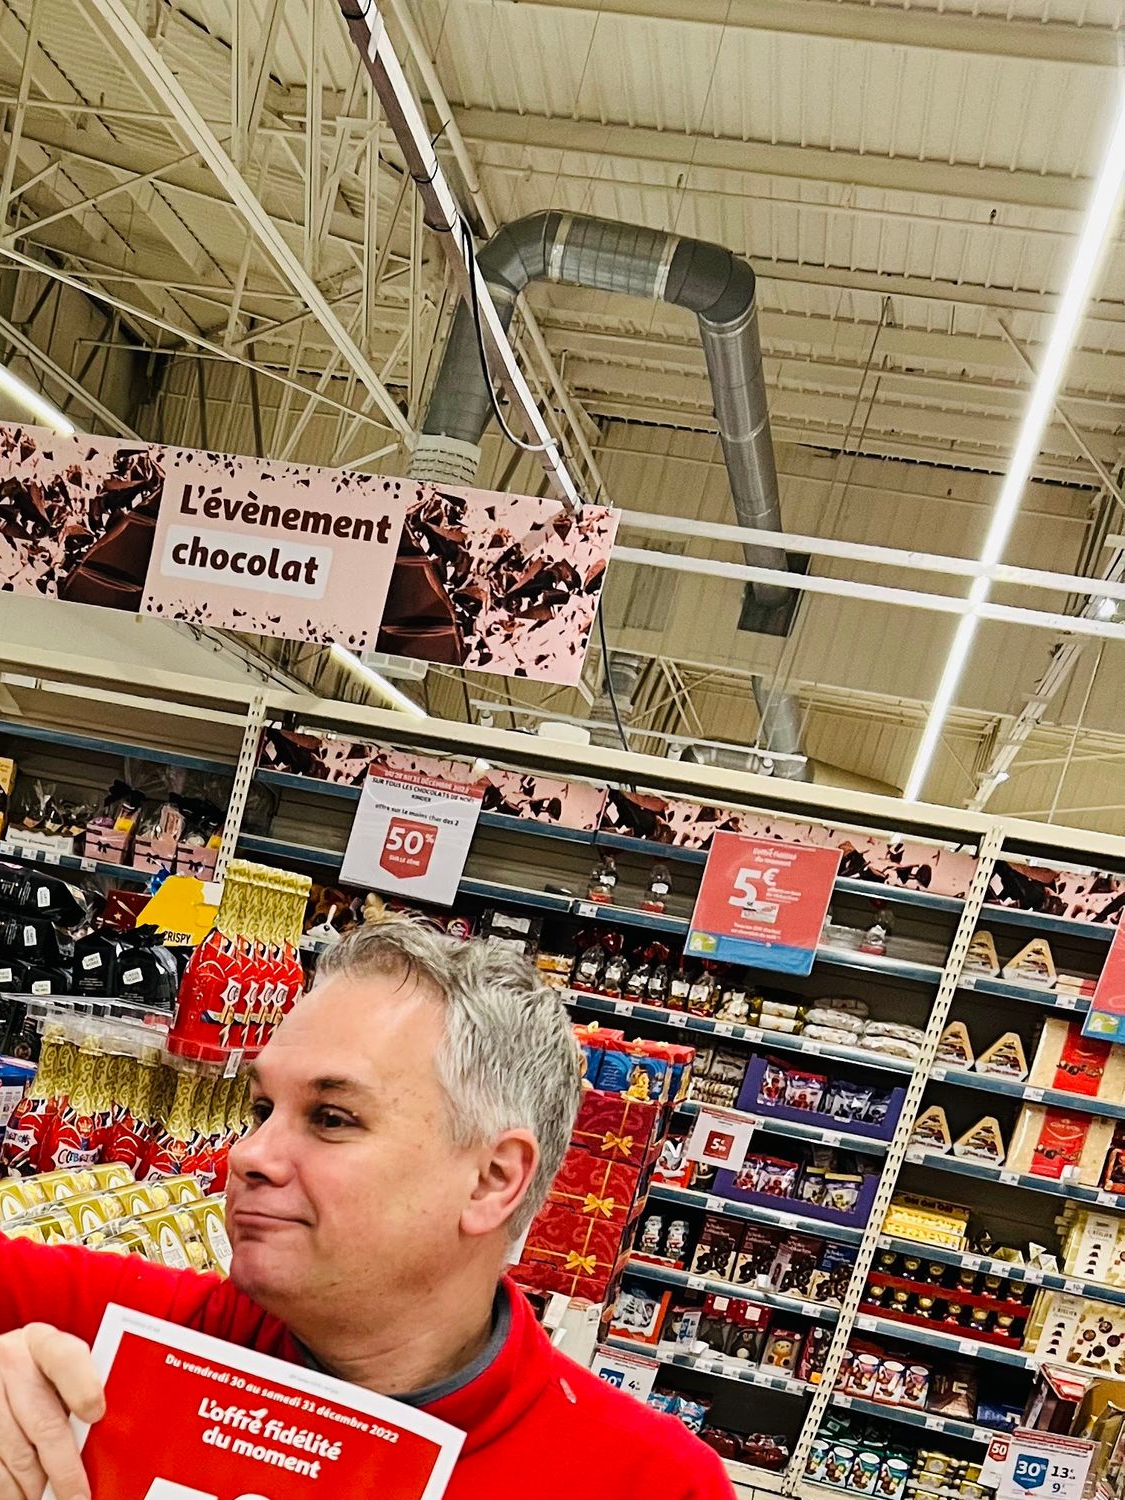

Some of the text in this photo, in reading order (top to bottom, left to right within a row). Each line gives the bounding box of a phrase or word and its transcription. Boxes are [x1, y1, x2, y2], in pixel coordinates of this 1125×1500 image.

[179, 484, 392, 544] L'évènement
[171, 536, 320, 585] chocolat
[414, 786, 450, 799] CHOCOLATS
[163, 930, 192, 944] CRISPY
[165, 1353, 181, 1368] Du
[182, 1360, 231, 1383] vendredi
[229, 1375, 246, 1389] 30
[245, 1383, 262, 1395] au
[261, 1388, 302, 1408] samedi
[302, 1399, 316, 1413] 31
[316, 1405, 369, 1432] décembre
[370, 1424, 400, 1444] 2022
[197, 1397, 343, 1461] L'offre fidélité
[201, 1426, 322, 1479] du moment
